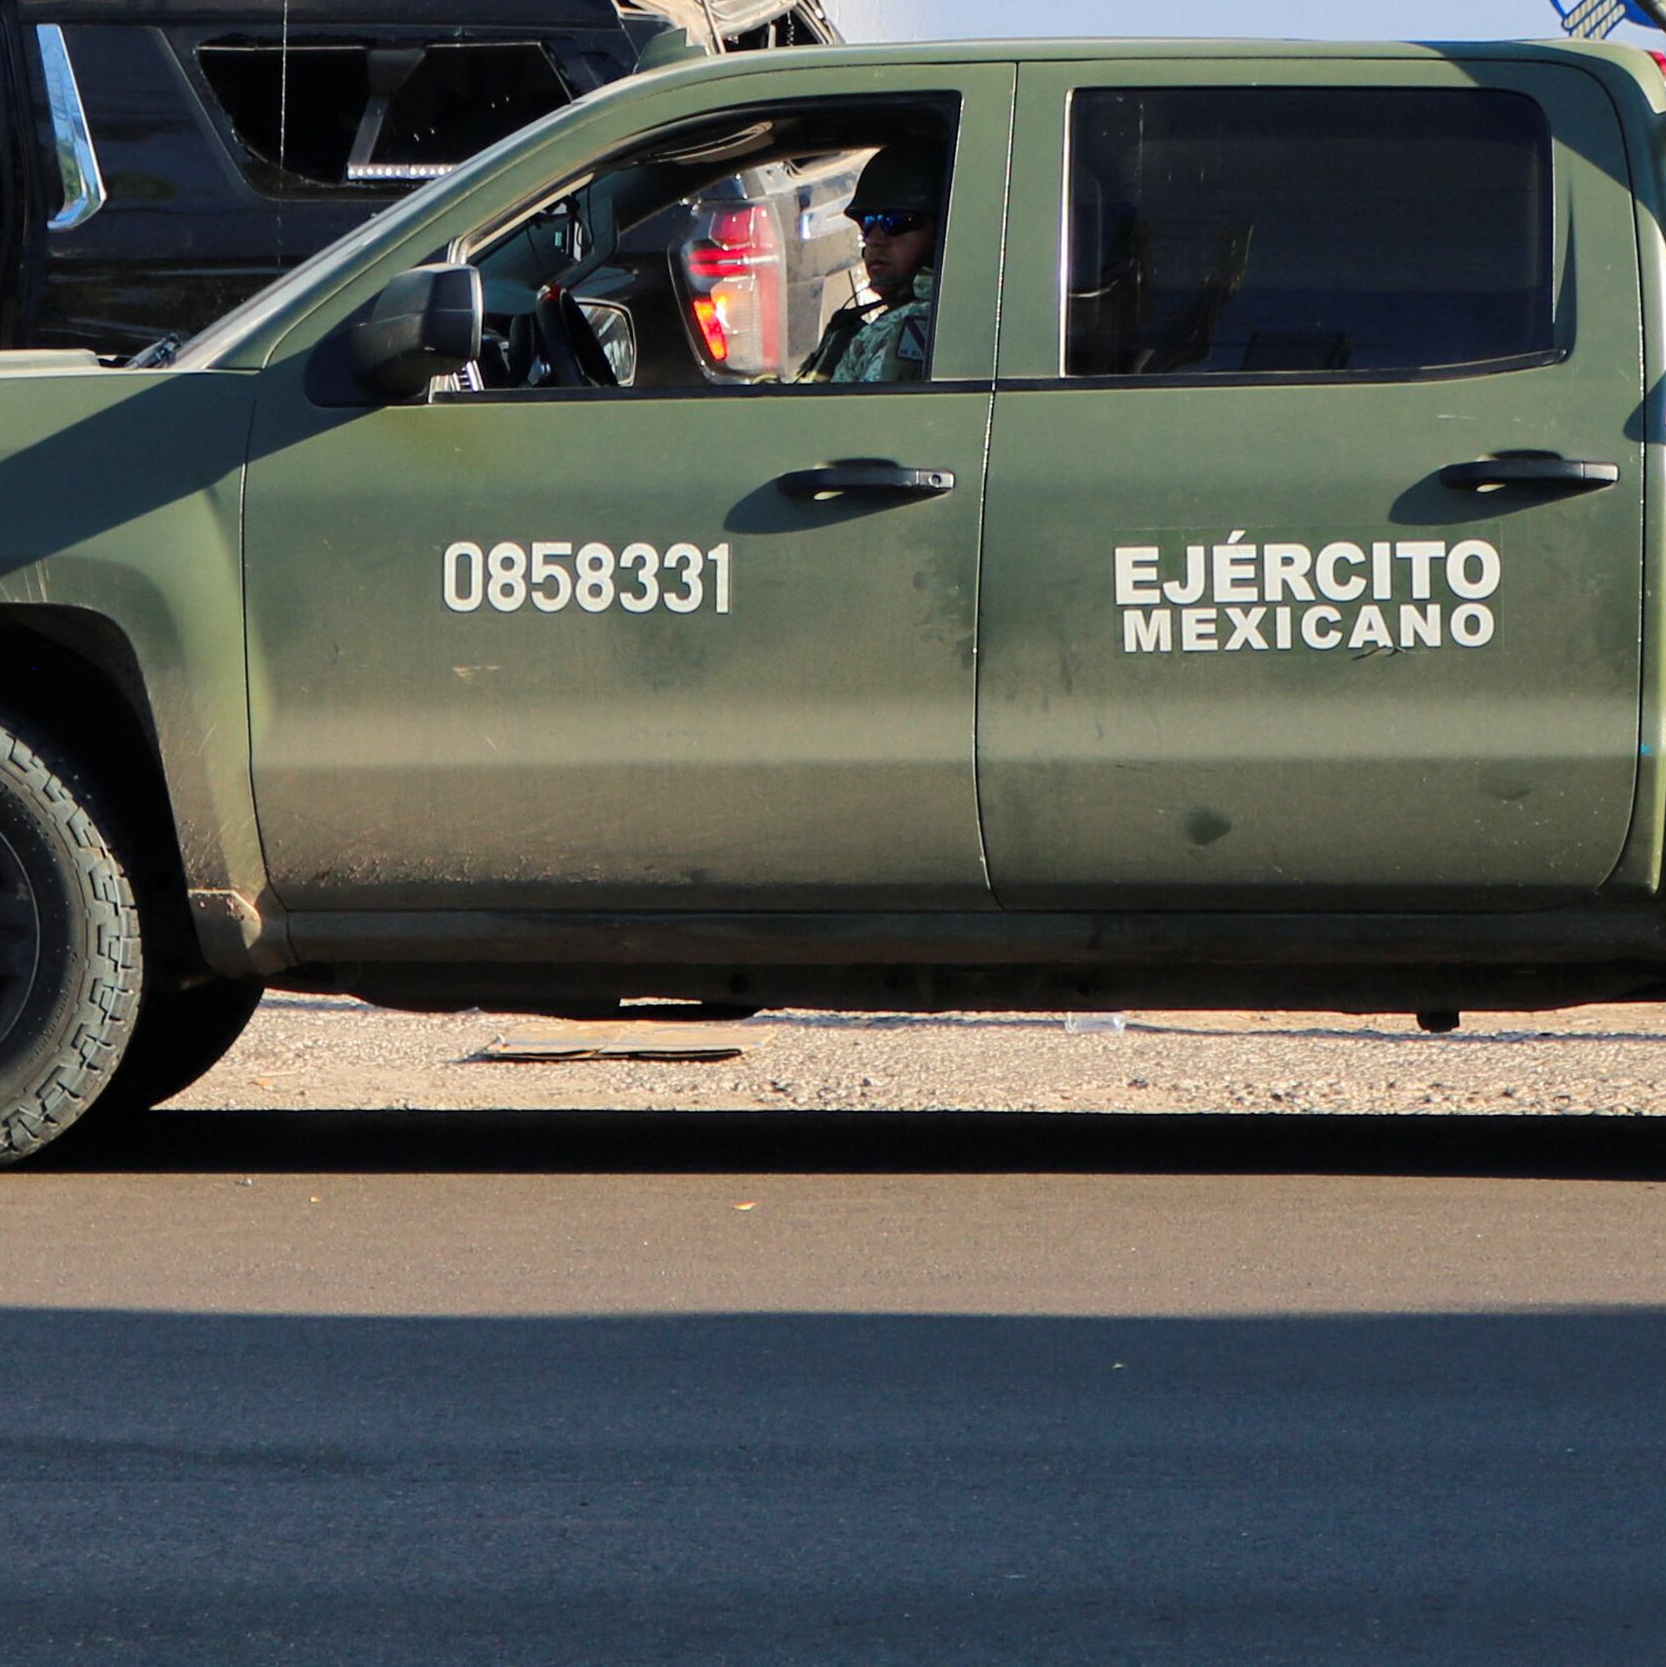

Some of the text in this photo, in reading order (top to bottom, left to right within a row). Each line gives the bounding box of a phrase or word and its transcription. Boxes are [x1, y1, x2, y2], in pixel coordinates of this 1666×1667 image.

[440, 541, 733, 615] 0858331
[1113, 529, 1503, 607] EJÉRCITO
[1122, 602, 1497, 654] MEXICANO
